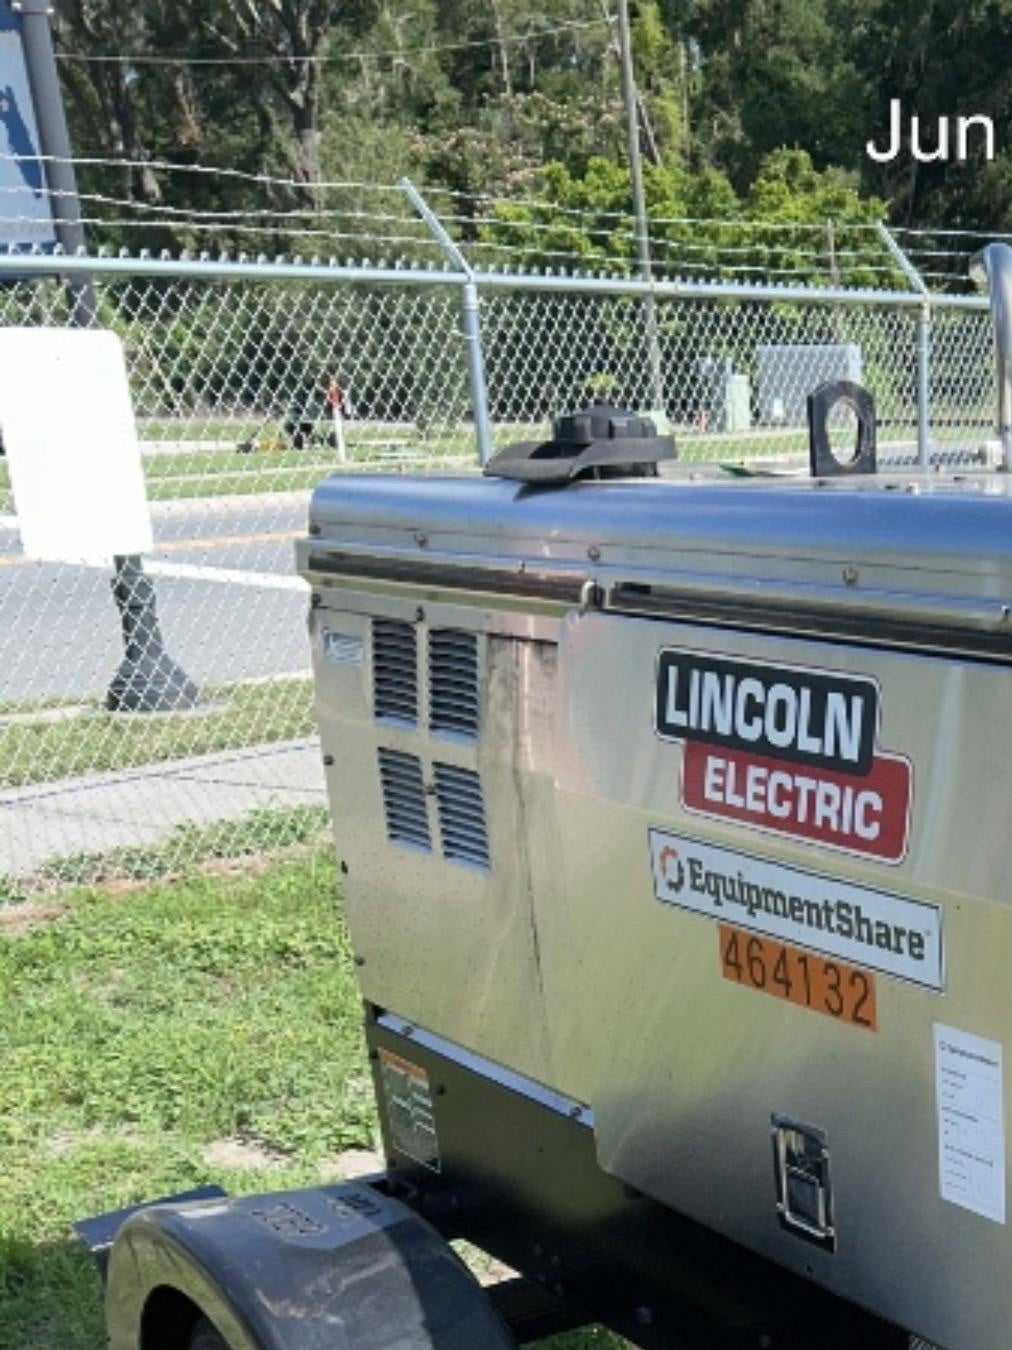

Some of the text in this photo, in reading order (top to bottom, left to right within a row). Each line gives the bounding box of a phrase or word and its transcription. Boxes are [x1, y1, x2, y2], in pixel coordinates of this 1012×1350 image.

[666, 665, 864, 762] LINCOLN
[703, 754, 883, 841] ELECTRIC
[687, 857, 925, 960] EquipmentShare
[724, 932, 873, 1027] 464132
